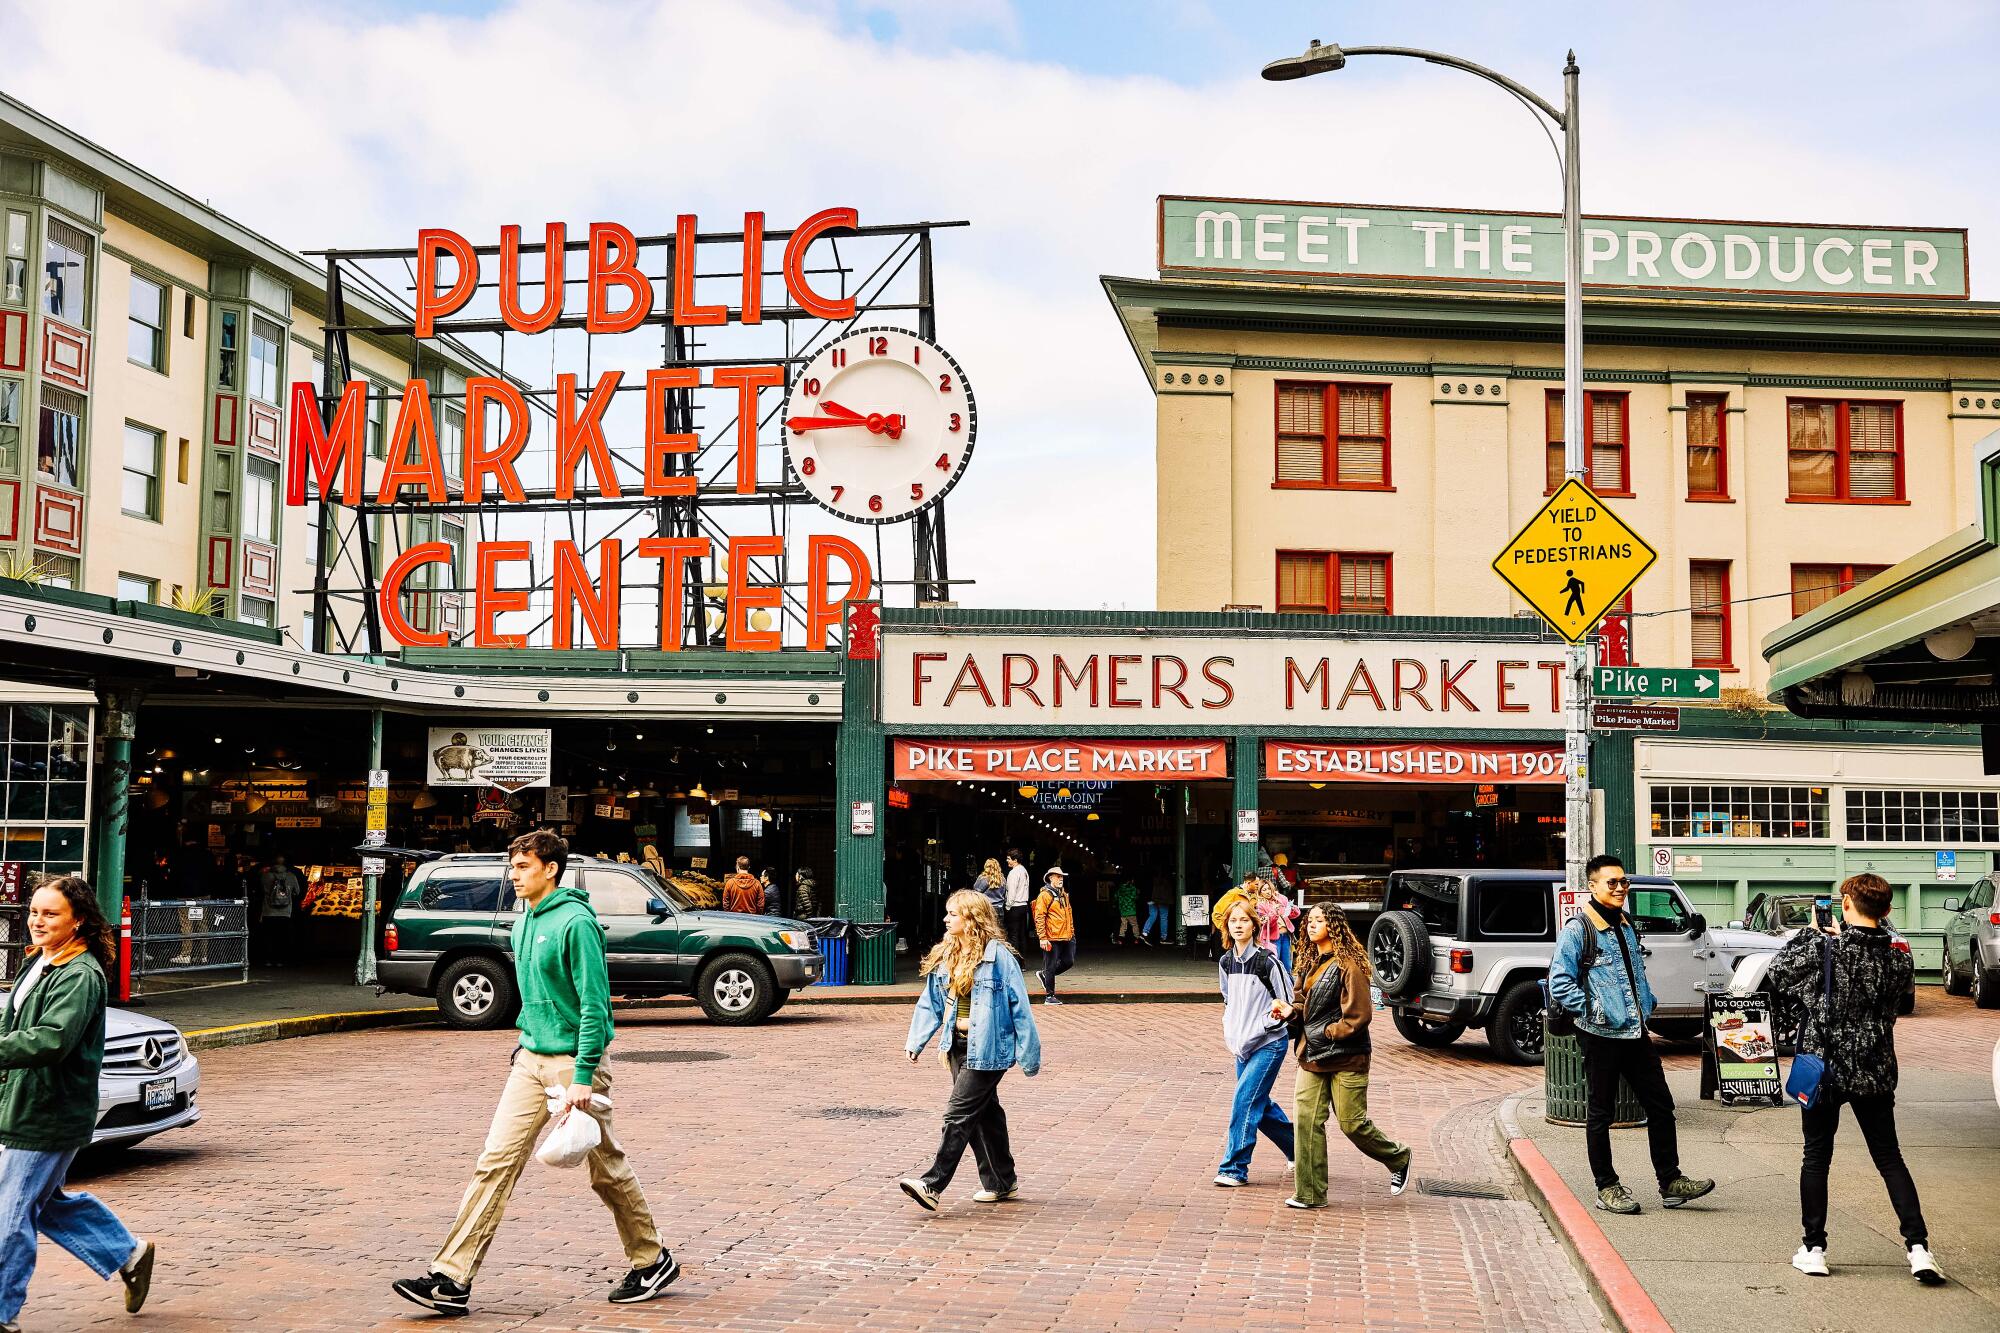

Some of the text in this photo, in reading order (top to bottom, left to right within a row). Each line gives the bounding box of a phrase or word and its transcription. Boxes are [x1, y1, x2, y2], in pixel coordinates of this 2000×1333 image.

[1195, 210, 1939, 286] MEET THE PRODUCER
[415, 207, 858, 339] PUBLIC
[869, 337, 888, 356] 12
[914, 346, 920, 365] 1
[832, 349, 846, 368] 11
[803, 378, 821, 397] 10
[939, 374, 952, 392] 2
[948, 413, 961, 432] 3
[286, 366, 785, 506] MARKET
[802, 457, 816, 476] 8
[935, 453, 950, 471] 4
[831, 486, 844, 502] 7
[911, 483, 923, 501] 5
[868, 495, 882, 512] 6
[1548, 507, 1596, 524] YIELD
[1563, 527, 1582, 542] TO
[1514, 543, 1632, 564] PEDESTRIANS
[379, 534, 872, 652] CENTER
[912, 652, 1566, 713] FARMERS MARKET
[1601, 669, 1677, 693] Pike Pl
[1596, 715, 1676, 726] Pike Place Market
[478, 734, 549, 747] YOUR CHANGE
[908, 748, 1212, 772] PIKE PLACE MARKET
[1277, 749, 1566, 775] ESTABLISHED IN 1907
[1032, 793, 1104, 803] VIEWPOINT
[1561, 894, 1572, 903] NO
[1564, 906, 1585, 917] STO
[1715, 999, 1766, 1009] los agaves
